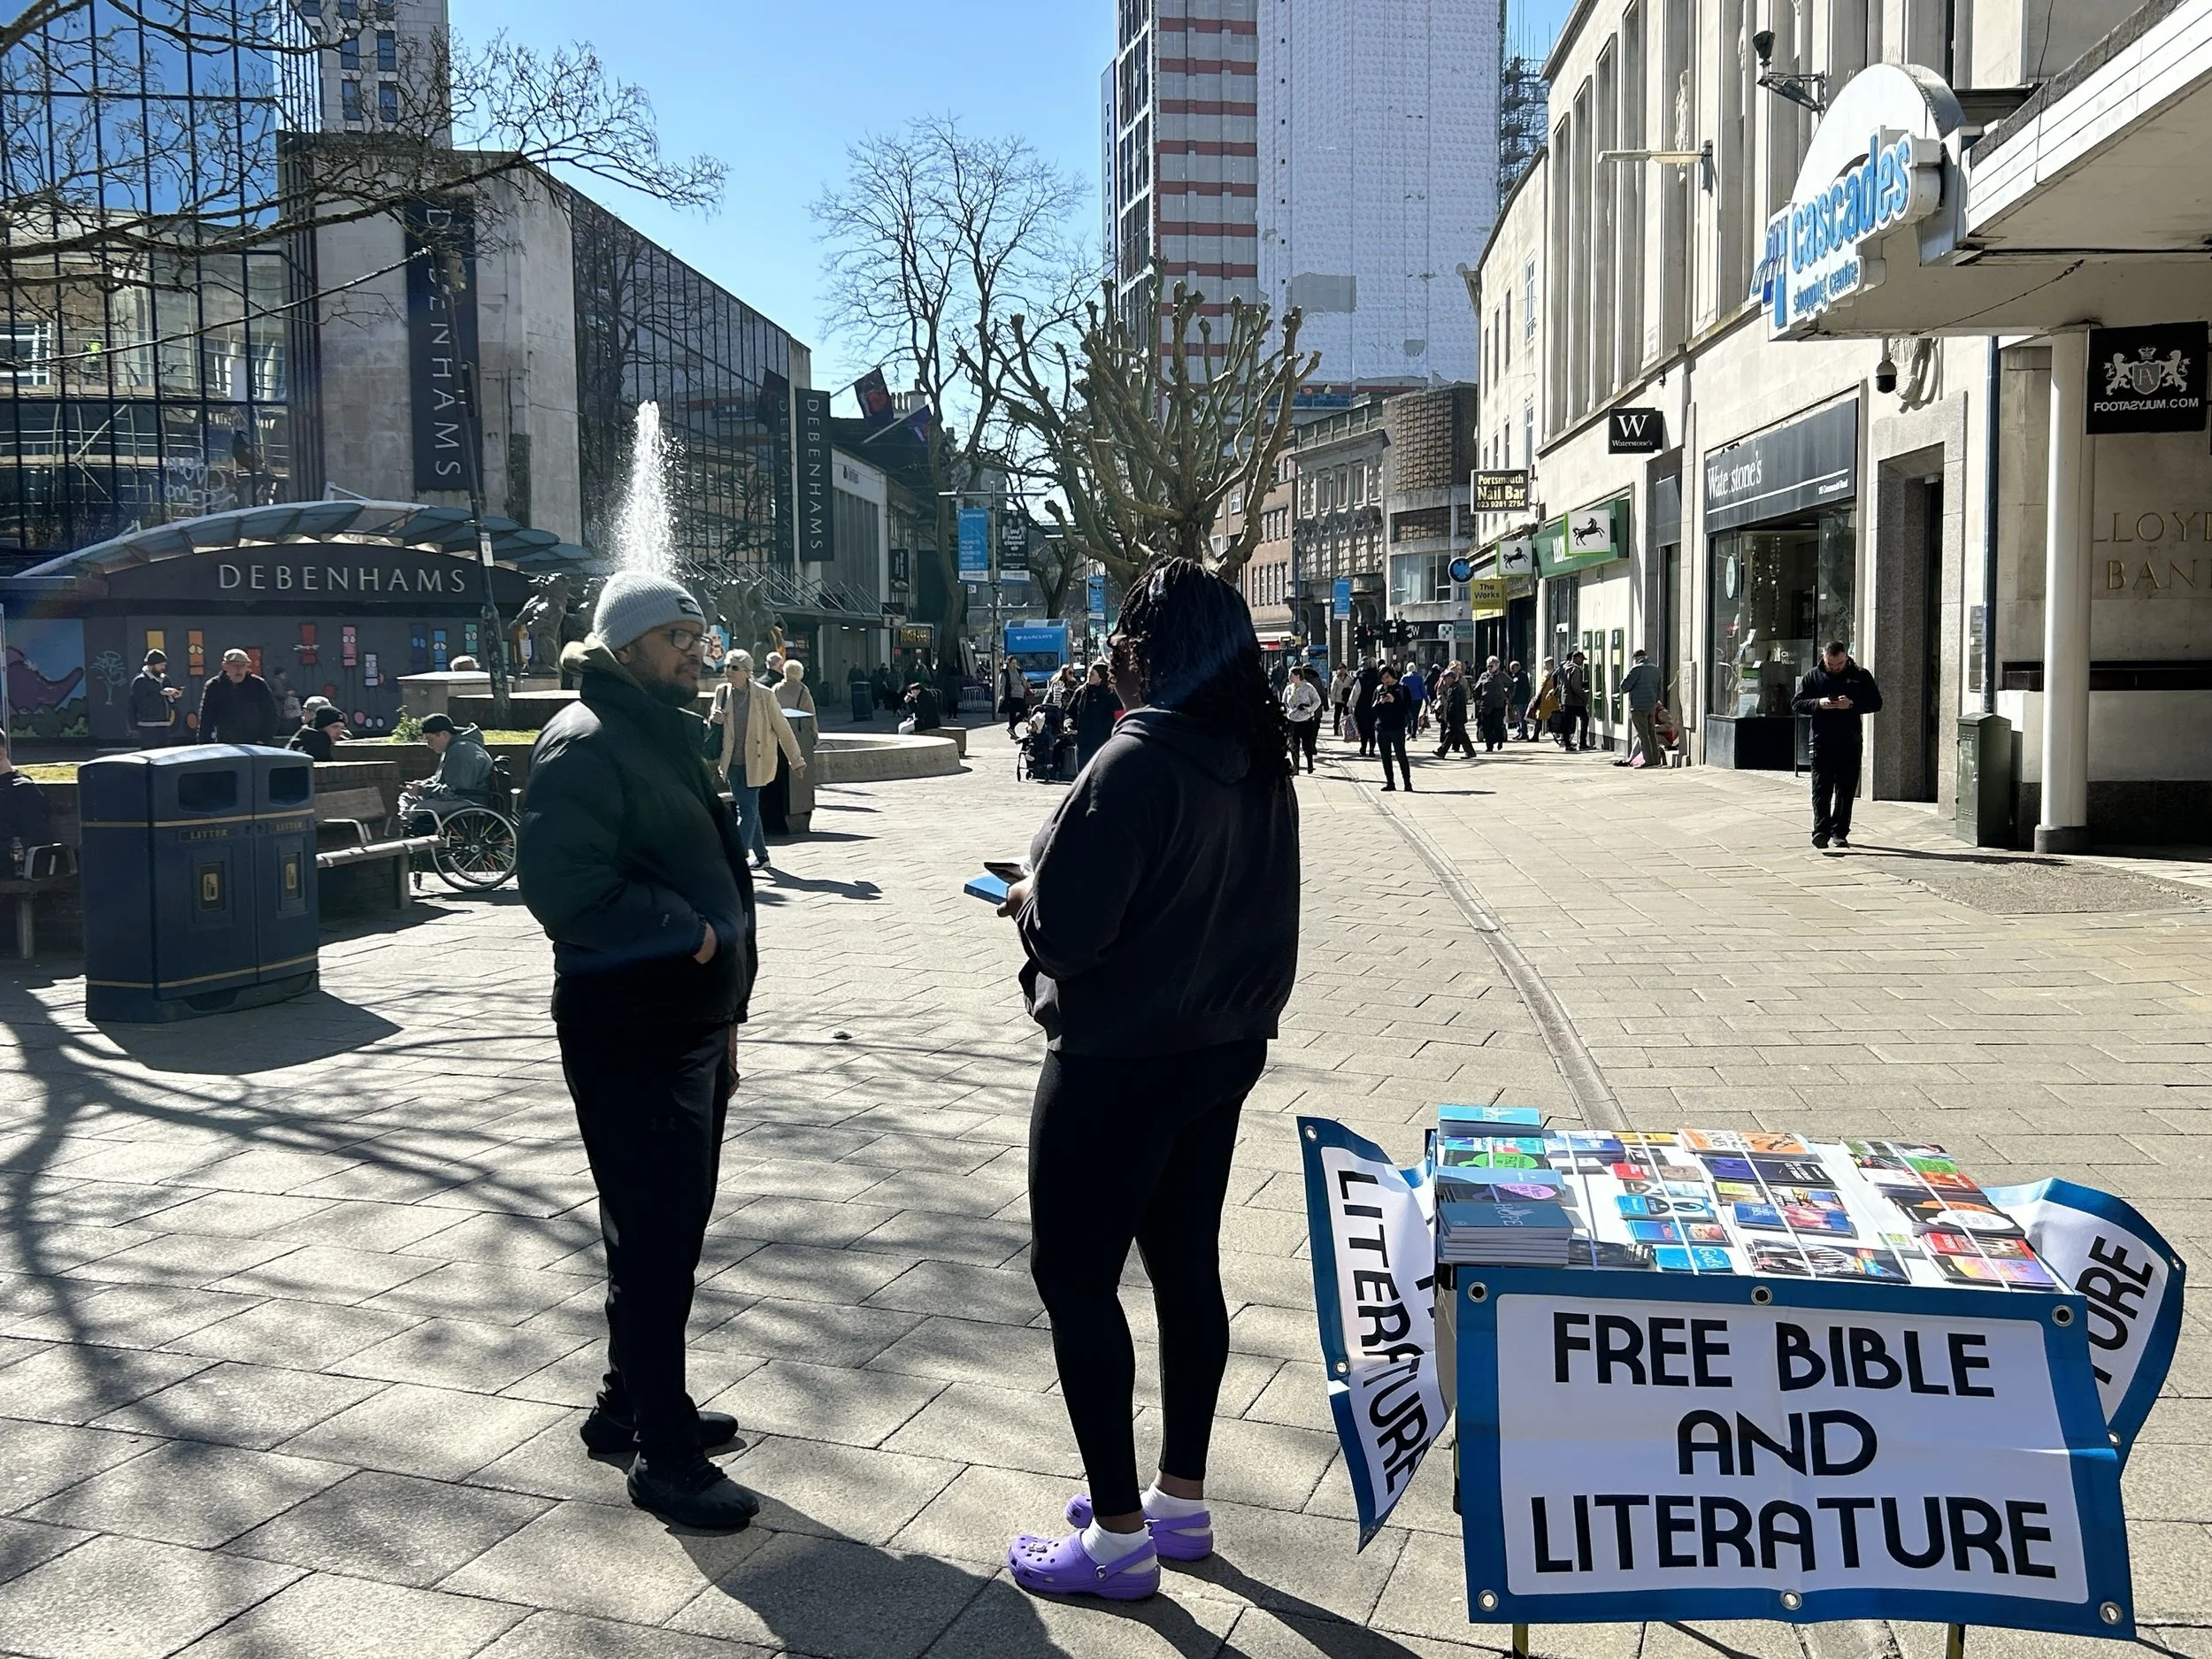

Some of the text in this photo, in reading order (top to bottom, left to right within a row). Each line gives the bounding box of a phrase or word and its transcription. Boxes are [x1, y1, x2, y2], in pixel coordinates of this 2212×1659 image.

[1792, 134, 1911, 274] cascades
[1793, 260, 1859, 317] shopping centre
[426, 209, 461, 476] DENHAMS
[1617, 414, 1649, 438] W
[806, 399, 823, 549] DEBENHAMS
[1477, 485, 1526, 500] Nail Bar
[1478, 474, 1524, 486] Portsmouth
[1707, 449, 1763, 501] Watestone's
[2093, 512, 2212, 541] LOY
[219, 564, 465, 593] DEBENHAMS
[2108, 559, 2212, 589] BAN
[190, 828, 228, 840] LITTER
[276, 821, 303, 831] LITTER
[1494, 1203, 1524, 1226] HOPE
[2075, 1235, 2154, 1386] URE
[1553, 1311, 1996, 1398] FREE BIBLE
[1678, 1409, 1878, 1477] AND
[1531, 1494, 2057, 1579] LITERATURE
